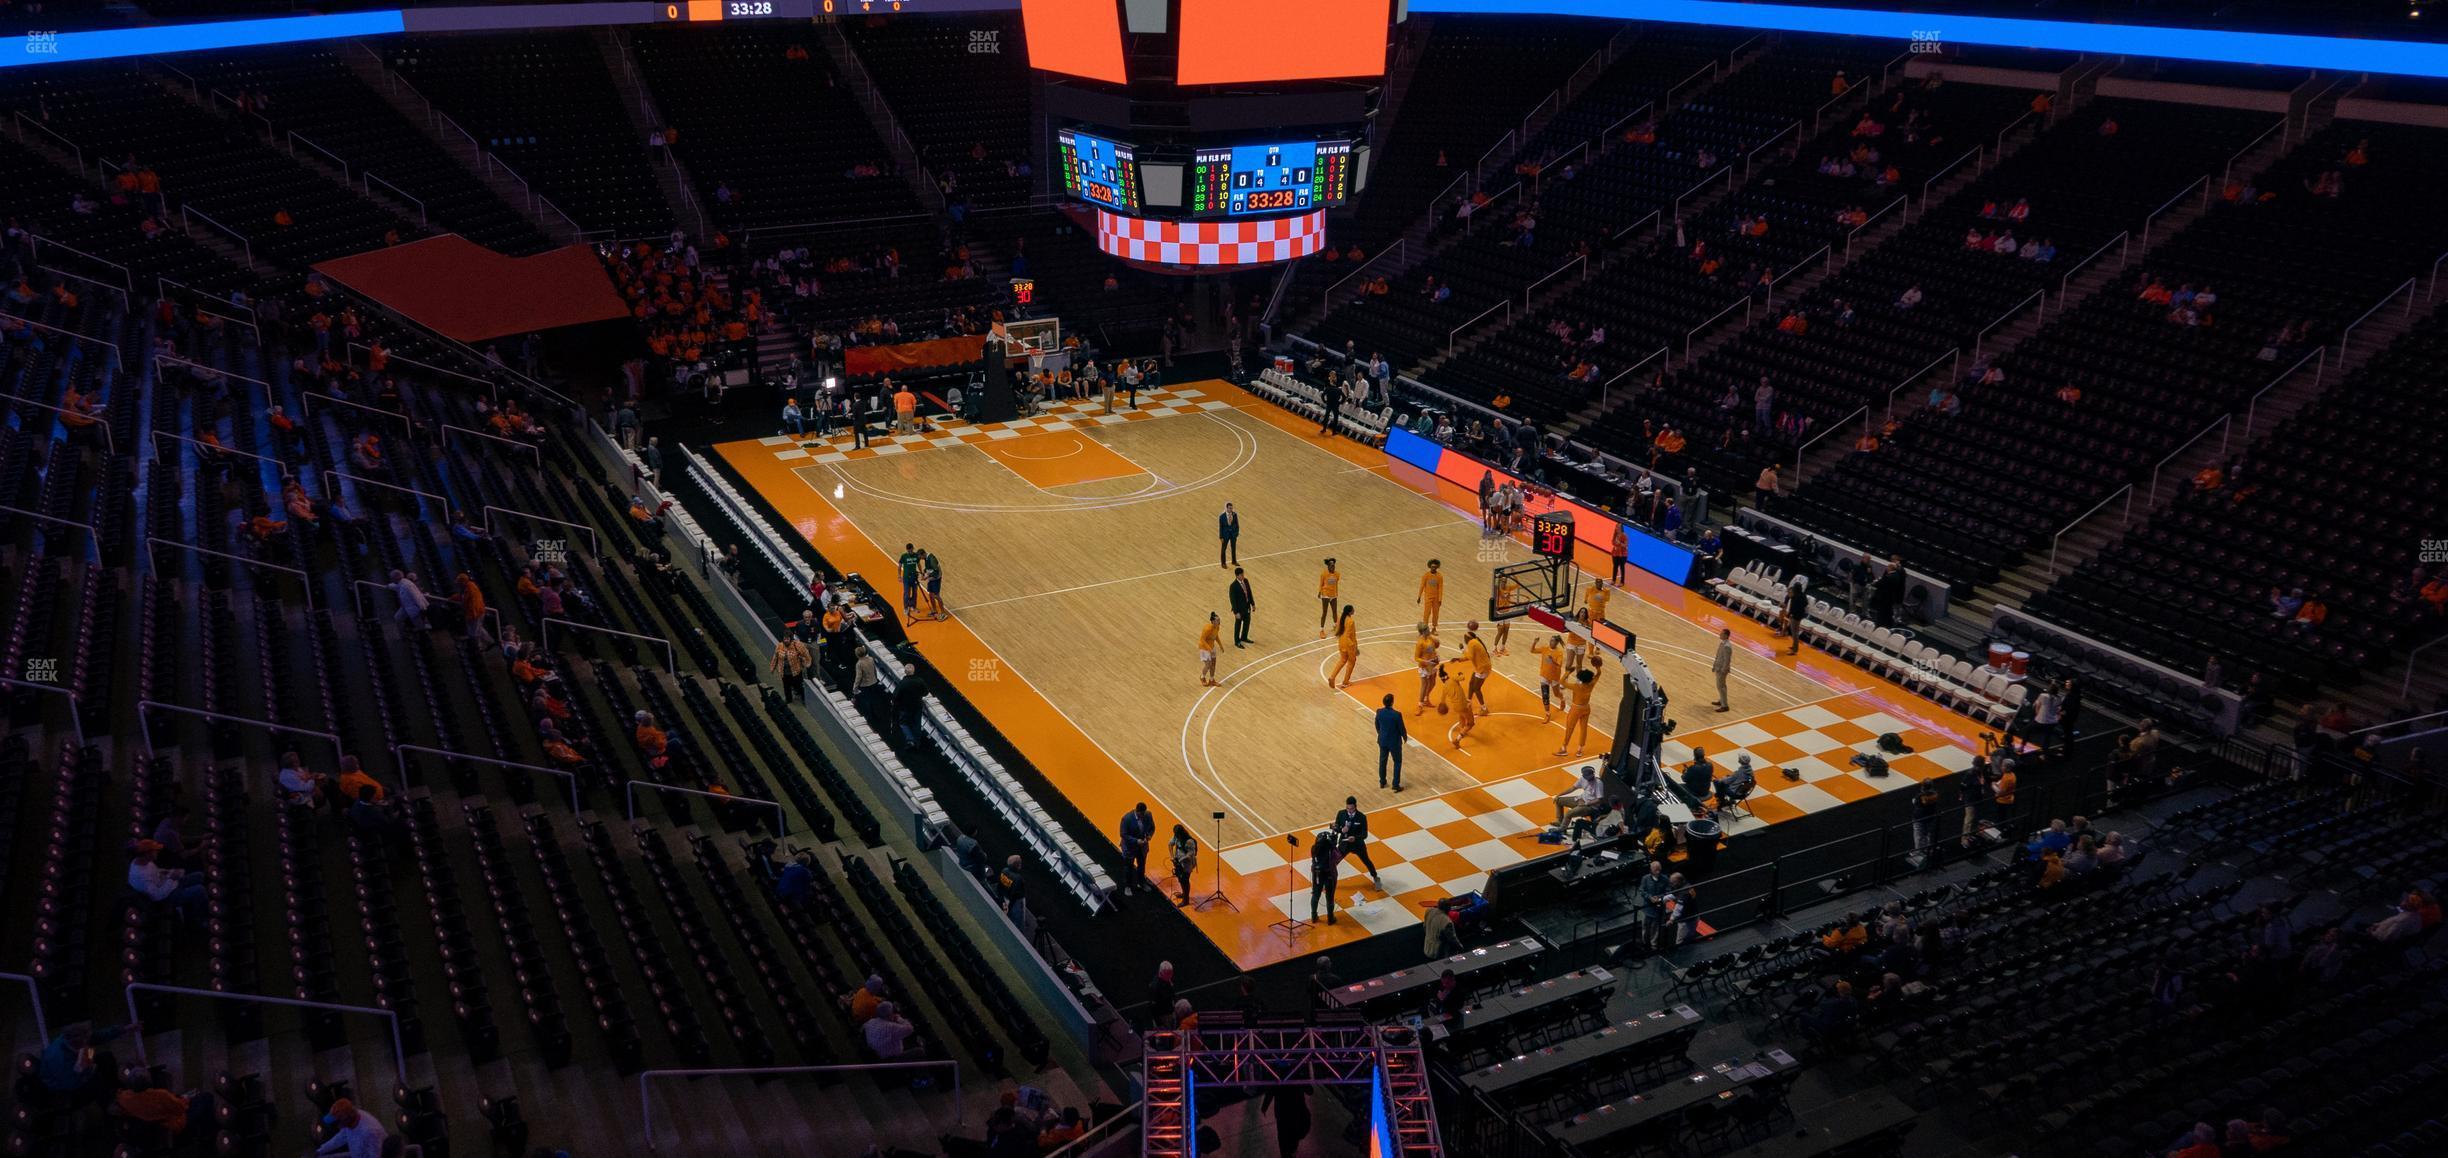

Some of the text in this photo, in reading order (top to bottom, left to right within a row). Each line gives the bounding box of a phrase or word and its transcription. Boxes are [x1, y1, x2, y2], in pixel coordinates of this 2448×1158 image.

[668, 0, 833, 18] 0 33:28 0
[1220, 154, 1231, 162] PTS
[1272, 155, 1276, 166] 1
[1340, 156, 1346, 164] 0
[1222, 164, 1228, 172] 9
[1220, 174, 1230, 182] 17
[1240, 170, 1305, 186] 0 0
[1257, 176, 1288, 186] 4 4
[1338, 182, 1343, 191] 2
[1090, 182, 1112, 202] 33:28
[1220, 192, 1228, 200] 10
[1337, 192, 1342, 200] 0
[1234, 190, 1306, 210] 0 33:28 0
[1208, 202, 1214, 210] 0
[1017, 291, 1030, 304] 30
[1538, 520, 1568, 536] 33:28
[1542, 532, 1562, 554] 30
